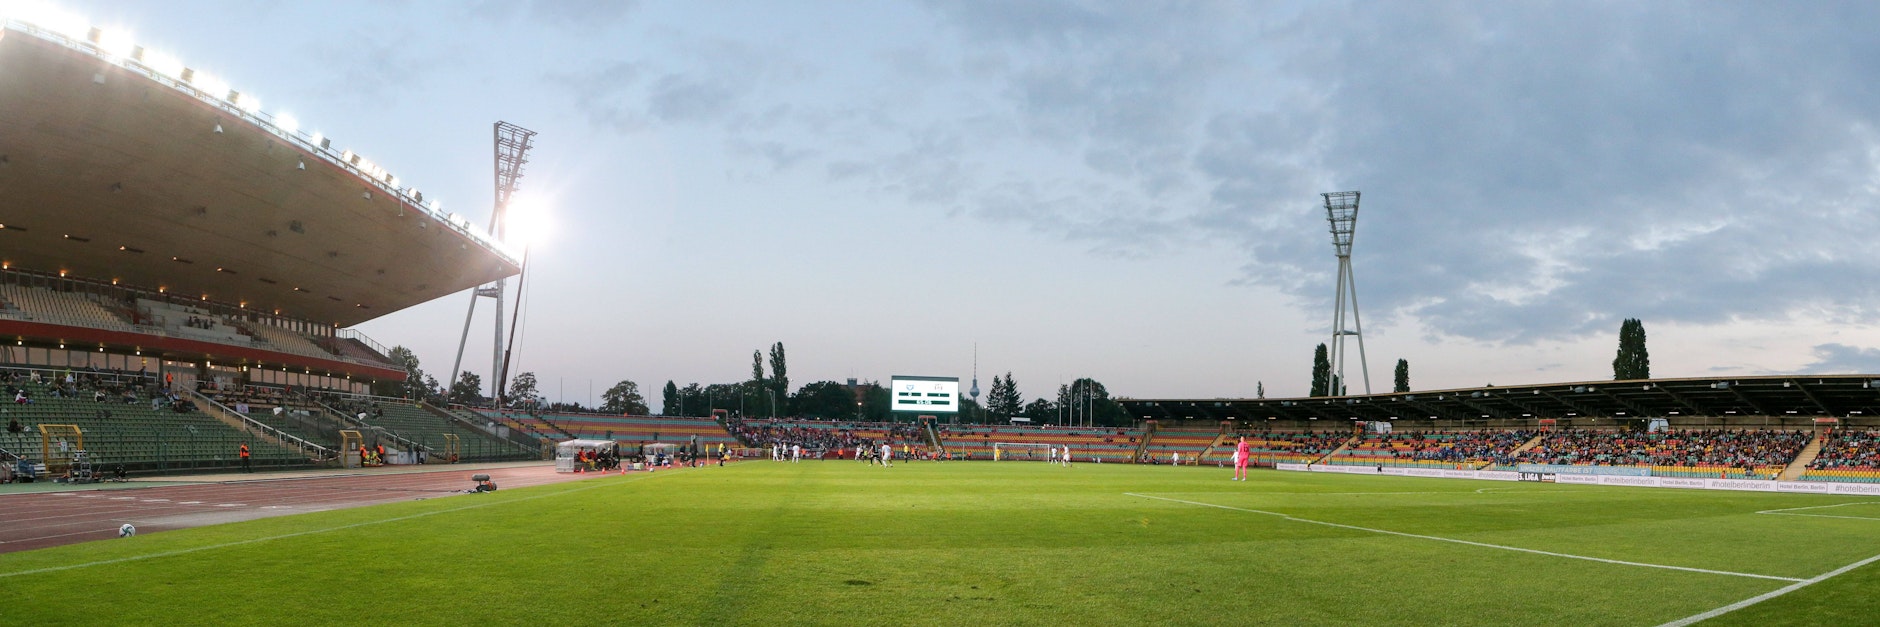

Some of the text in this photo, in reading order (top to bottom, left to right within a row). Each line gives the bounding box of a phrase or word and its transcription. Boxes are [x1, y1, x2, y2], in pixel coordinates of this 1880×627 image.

[1520, 465, 1543, 473] UNSERE
[1525, 473, 1539, 481] LIGA
[1712, 480, 1770, 489] #hotelberlinberlin
[1835, 485, 1880, 493] #hotelberlin
